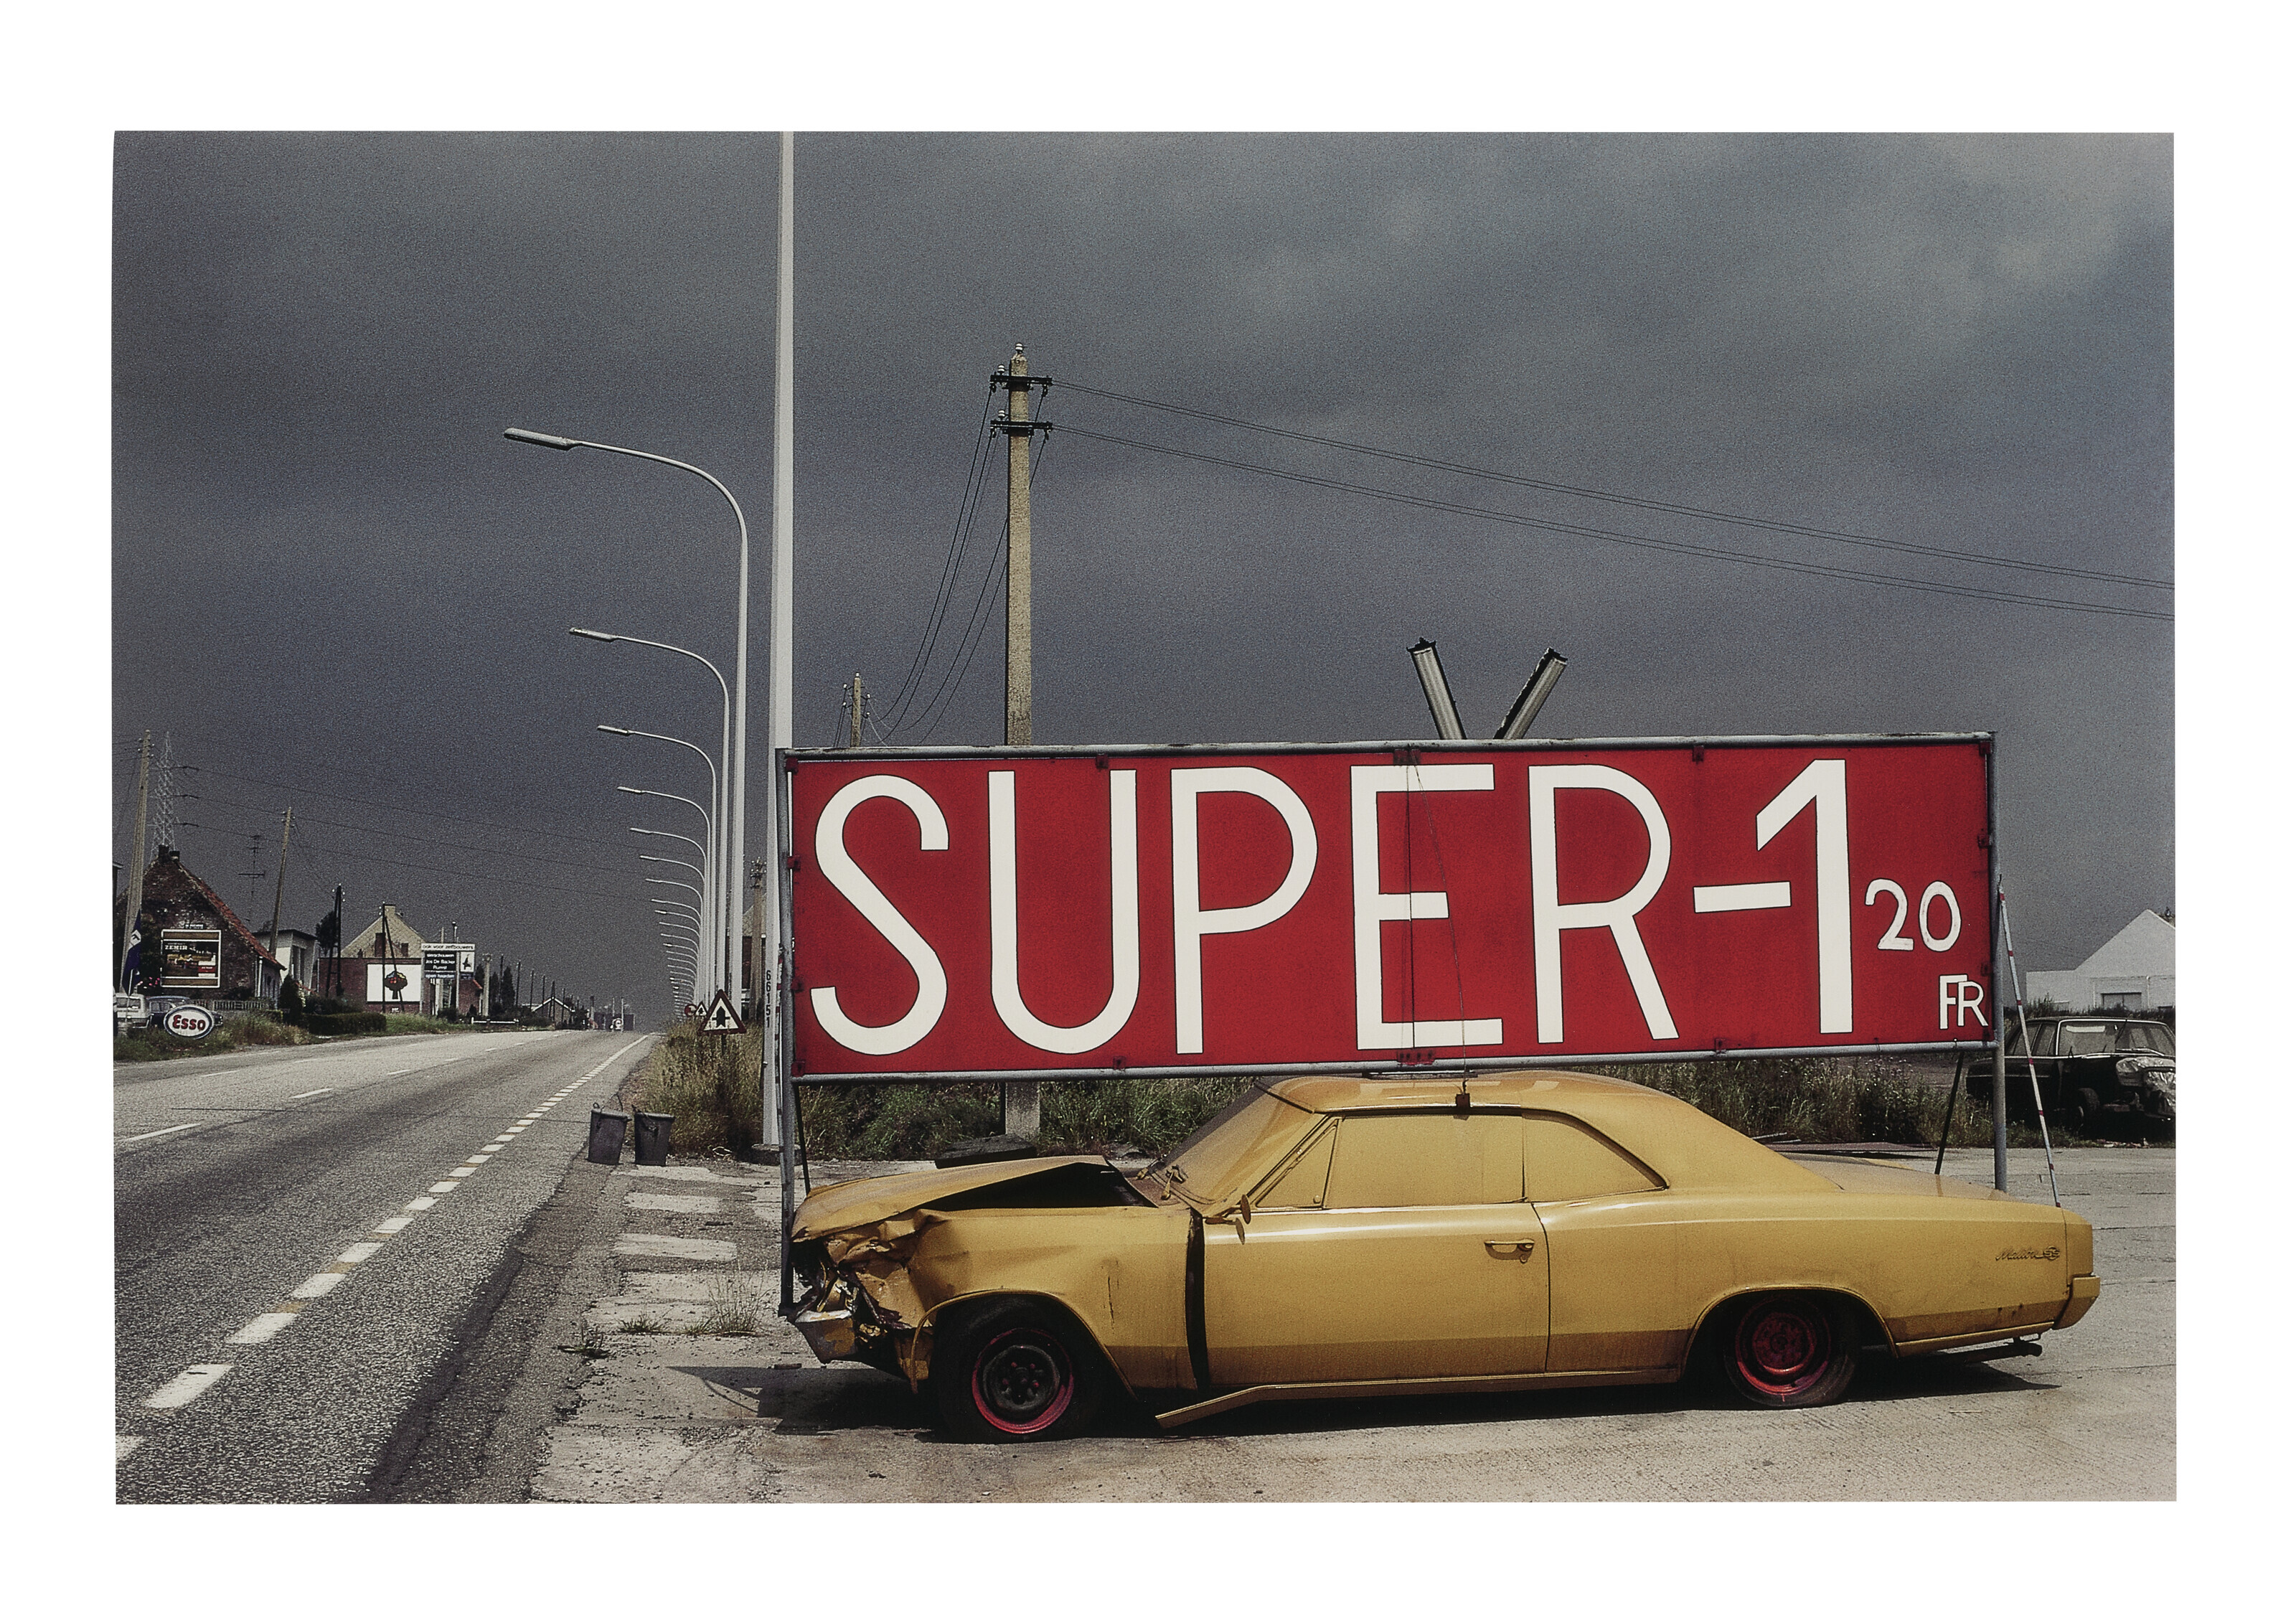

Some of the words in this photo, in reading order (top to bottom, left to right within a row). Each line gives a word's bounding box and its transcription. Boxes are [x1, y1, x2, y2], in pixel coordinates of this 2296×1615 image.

[1864, 878, 1962, 952] 20
[172, 1014, 206, 1031] Esso
[1939, 974, 1989, 1030] FR
